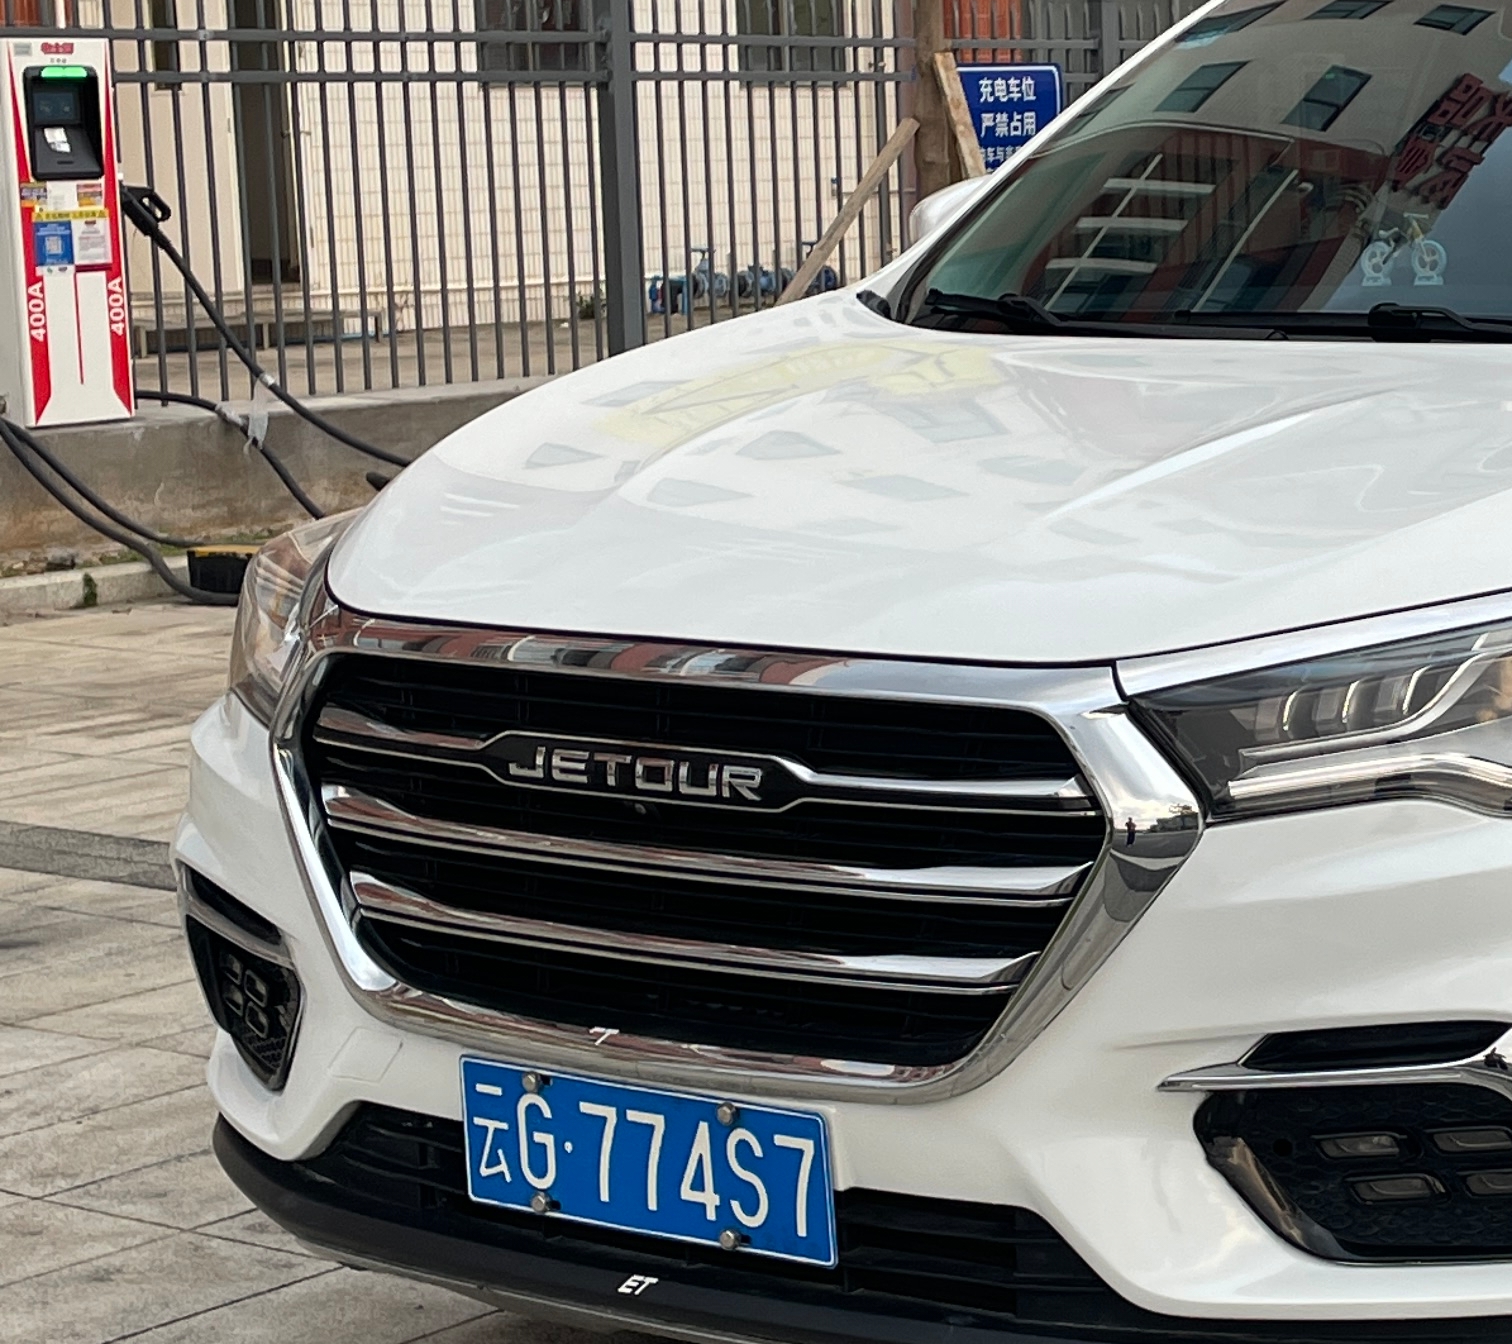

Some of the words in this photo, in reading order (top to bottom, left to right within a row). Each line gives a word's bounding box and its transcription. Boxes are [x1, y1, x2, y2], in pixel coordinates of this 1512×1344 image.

[978, 76, 1036, 103] 充电车位
[980, 111, 1037, 138] 严禁占用
[28, 282, 46, 341] 400A
[108, 276, 125, 336] 400A
[508, 746, 763, 801] JETOUR
